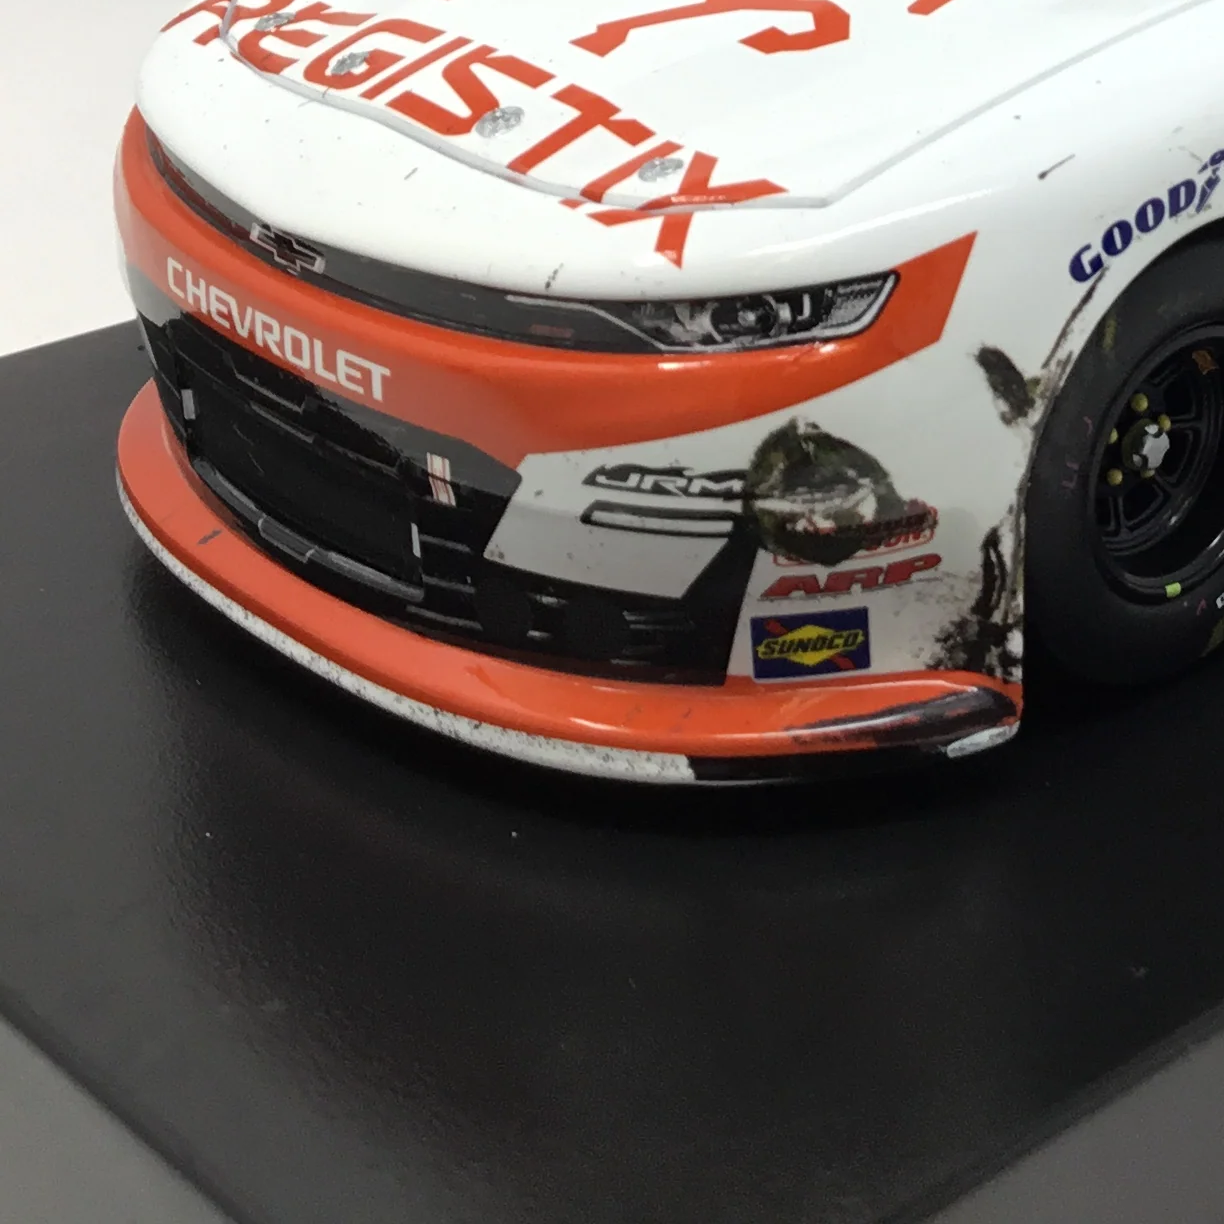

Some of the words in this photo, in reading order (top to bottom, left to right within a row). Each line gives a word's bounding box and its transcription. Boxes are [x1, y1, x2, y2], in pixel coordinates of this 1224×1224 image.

[166, 255, 391, 403] CHEVROLET
[757, 553, 943, 601] ARP
[760, 629, 859, 659] SUNOCO
